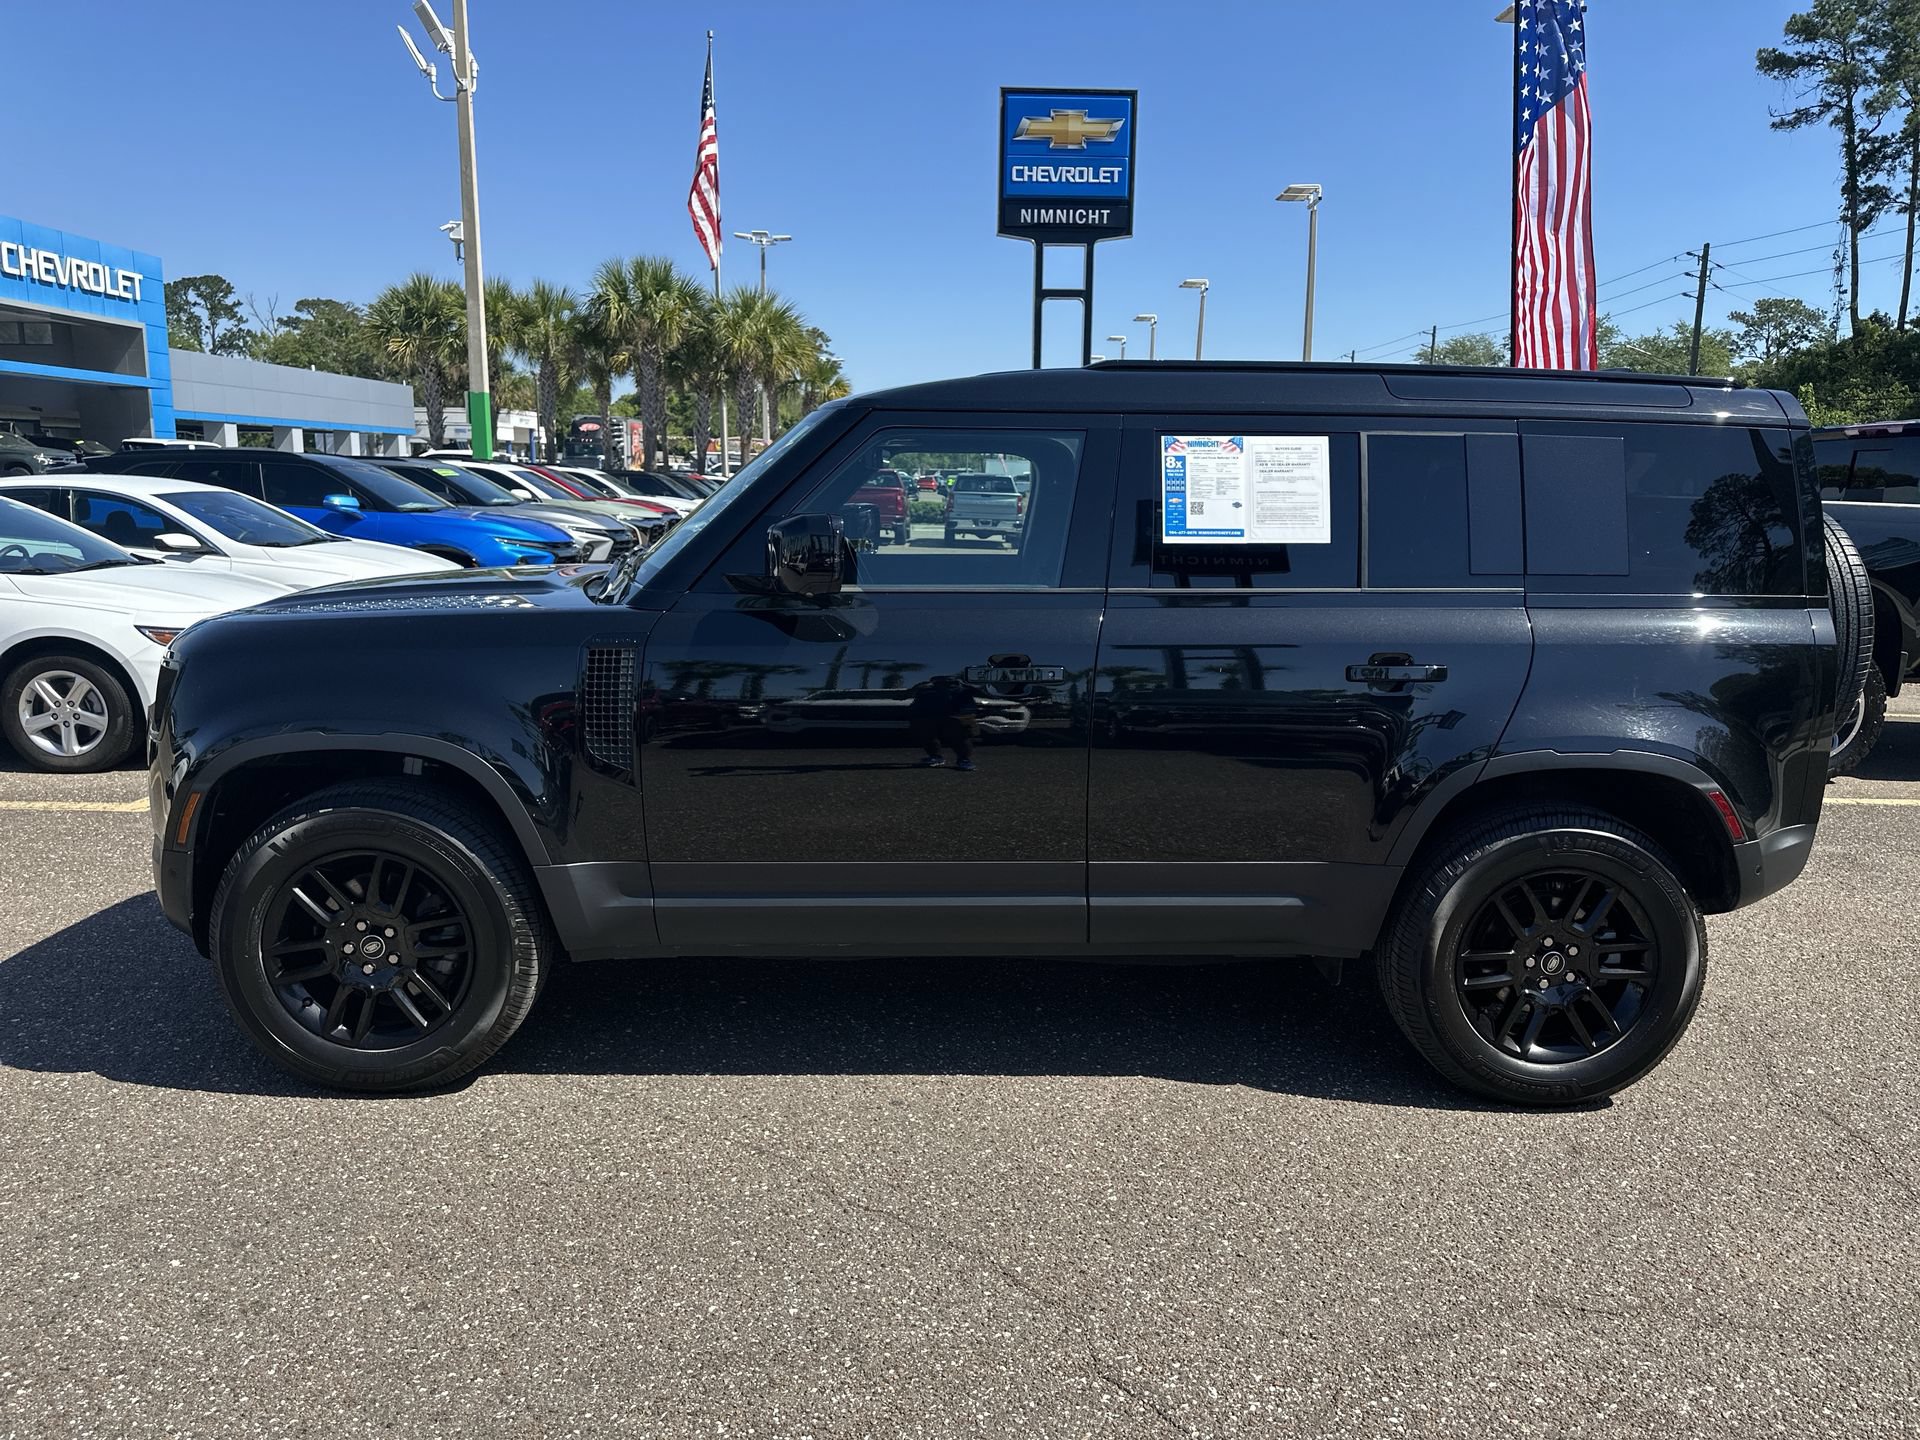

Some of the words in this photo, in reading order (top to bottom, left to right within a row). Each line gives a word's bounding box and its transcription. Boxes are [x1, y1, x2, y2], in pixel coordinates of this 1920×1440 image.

[1011, 165, 1123, 183] CHEVROLET
[1020, 208, 1111, 224] NIMNICHT
[1, 240, 144, 301] CHEVROLET
[1187, 440, 1220, 448] NIMNICHT
[1165, 456, 1183, 469] 8x
